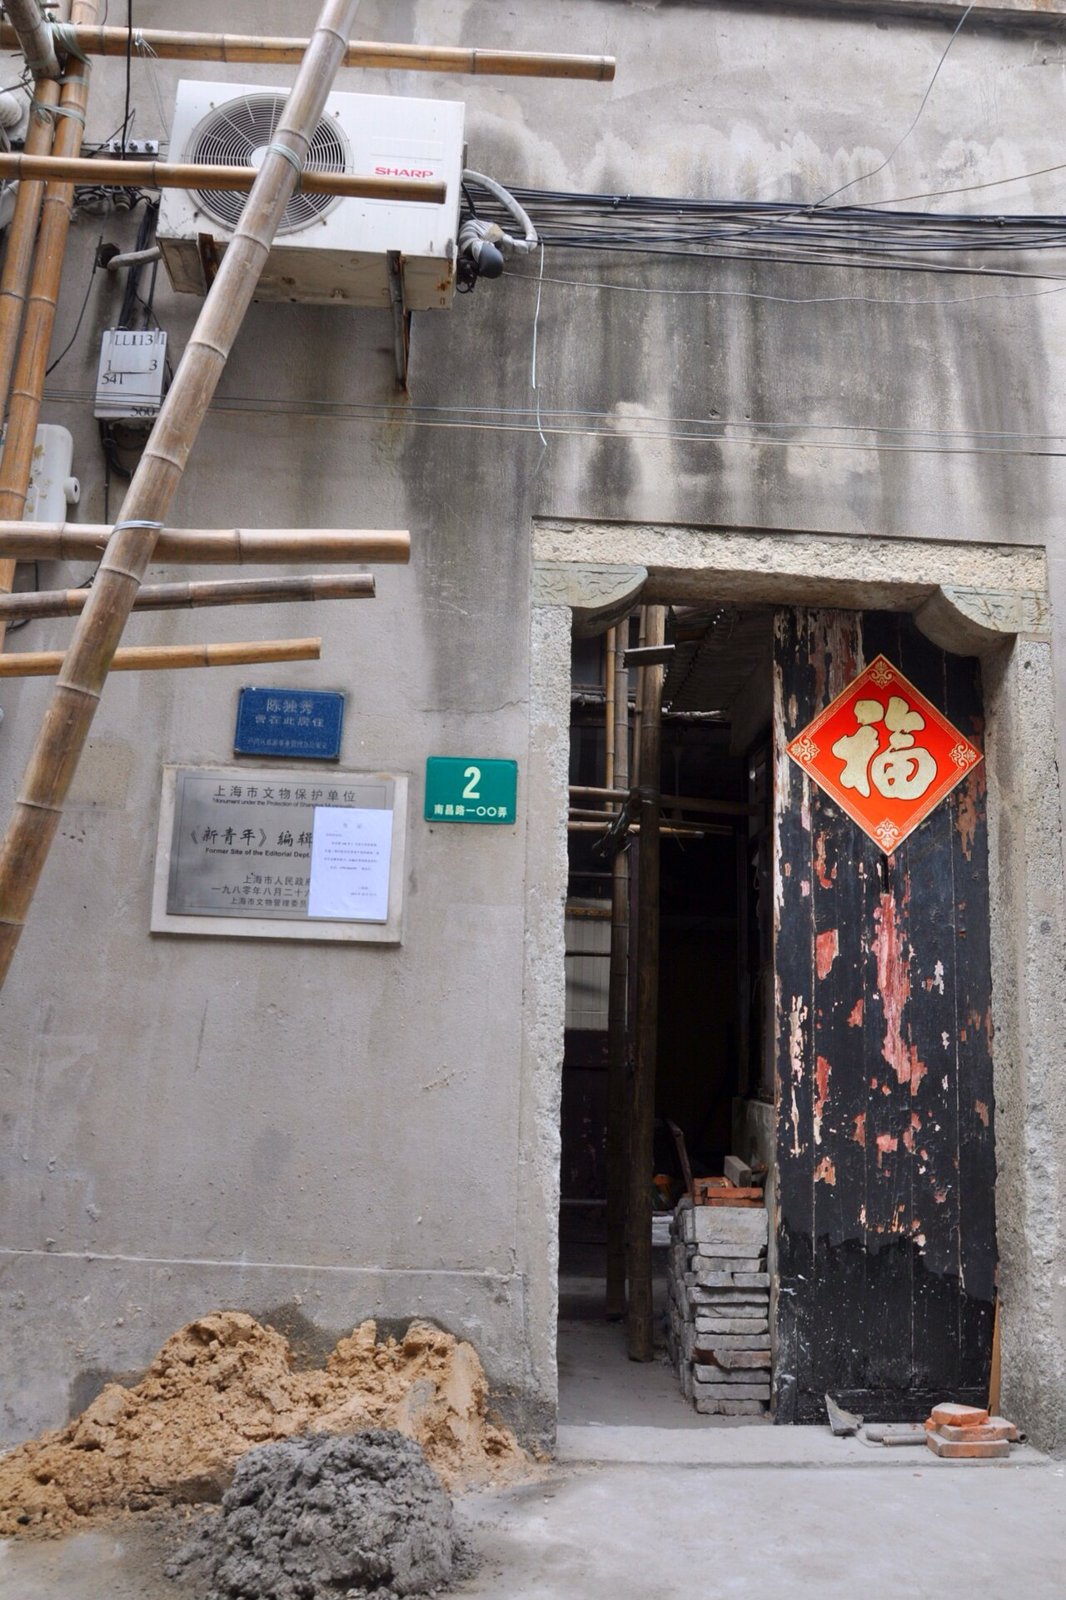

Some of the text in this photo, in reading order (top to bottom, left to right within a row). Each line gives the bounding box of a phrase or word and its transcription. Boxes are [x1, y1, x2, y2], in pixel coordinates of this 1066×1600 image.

[375, 166, 434, 178] SHARP
[832, 696, 938, 800] 福
[214, 785, 356, 802] 上海市文物保护单位
[462, 766, 481, 799] 2
